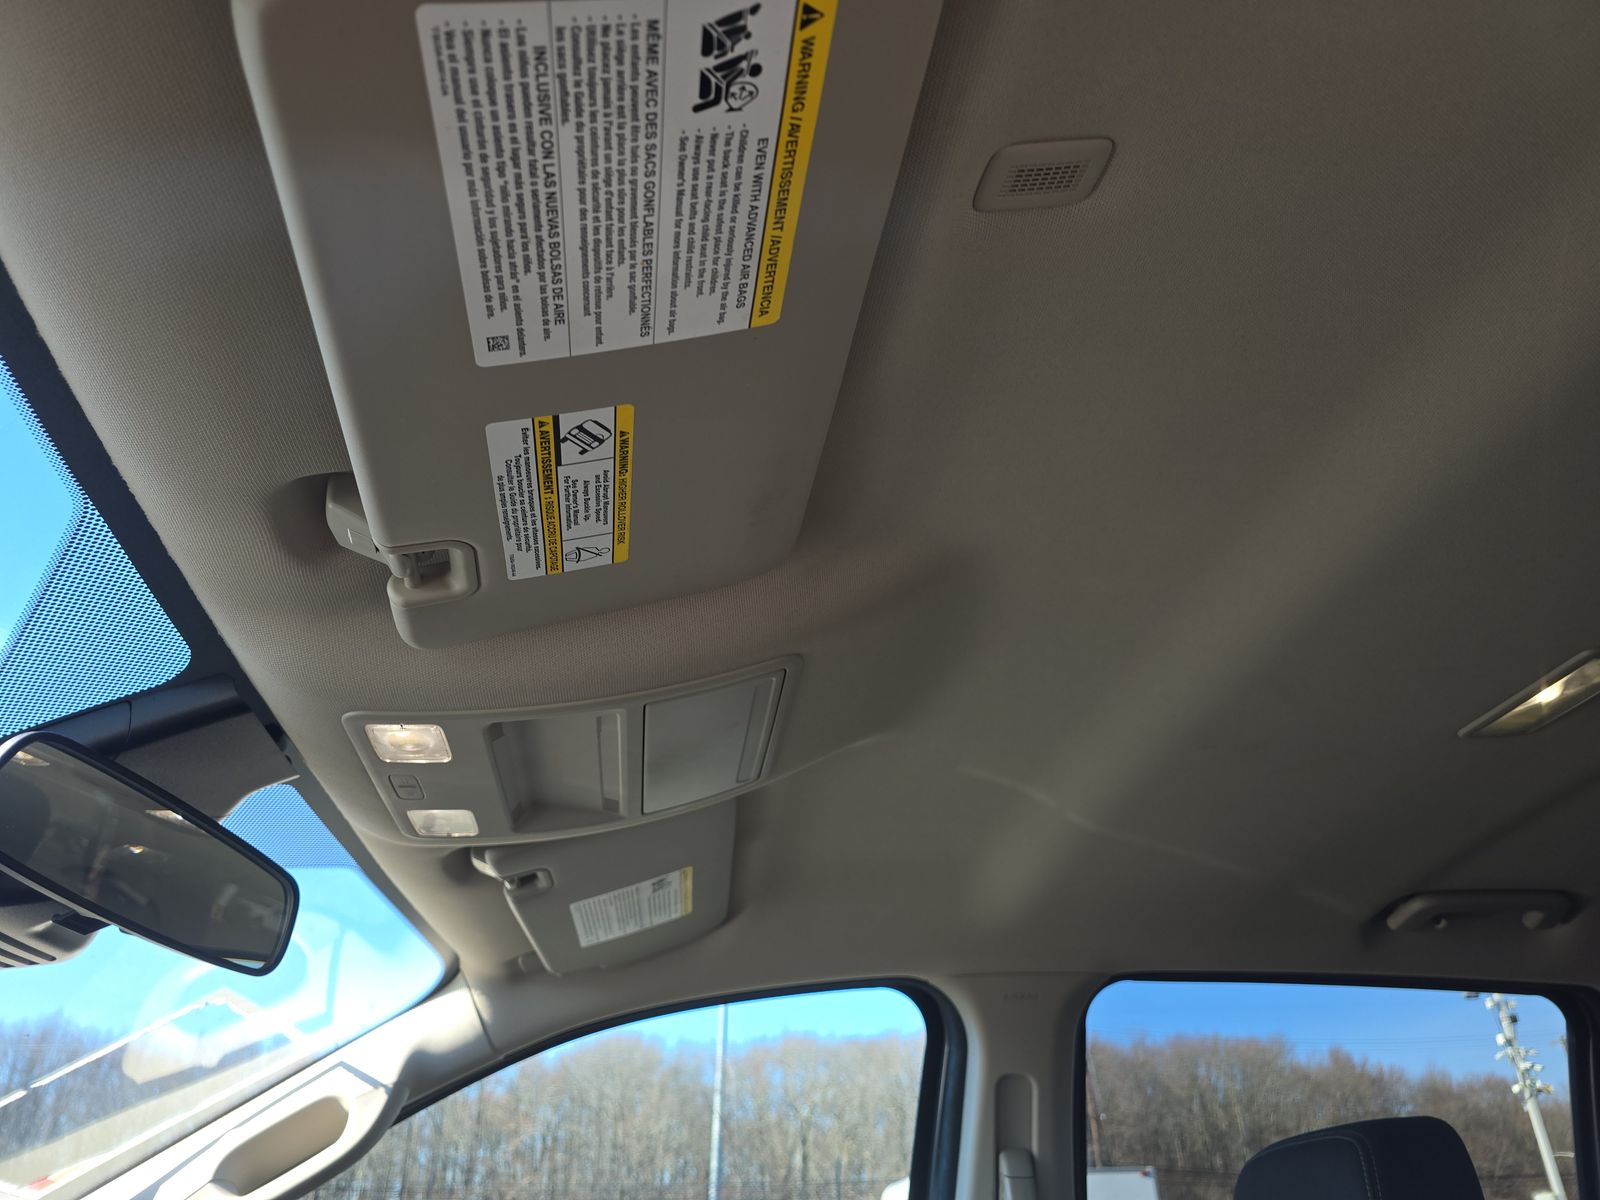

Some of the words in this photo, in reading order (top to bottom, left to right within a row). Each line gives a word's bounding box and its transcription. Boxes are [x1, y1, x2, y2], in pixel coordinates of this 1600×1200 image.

[645, 19, 662, 66] MÊME
[533, 45, 553, 127] INCLUSIVE
[645, 69, 659, 108] AVEC
[791, 36, 816, 113] WARNING
[644, 112, 658, 140] DES
[540, 130, 555, 160] CON
[754, 138, 769, 170] EVEN
[644, 143, 657, 178] SACS
[542, 163, 557, 189] LAS
[750, 172, 764, 202] WITH
[545, 191, 560, 239] NUEVAS
[642, 181, 656, 256] GONFLABLES
[742, 204, 759, 262] ADVANCED
[548, 241, 563, 285] BOLSAS
[739, 264, 751, 281] AIR
[552, 287, 564, 301] DE
[640, 259, 653, 337] PERFECTIONNÉS
[736, 282, 749, 308] BAGS
[553, 303, 565, 325] AIRE
[539, 430, 554, 495] AVERTISSEMENT
[618, 478, 627, 501] HIGHER
[545, 501, 555, 520] RISQUE
[617, 502, 627, 531] ROLLOVER
[546, 521, 557, 538] ACCRU
[548, 538, 557, 546] DE
[617, 532, 626, 544] RISK
[549, 546, 559, 572] CAPOTAGE
